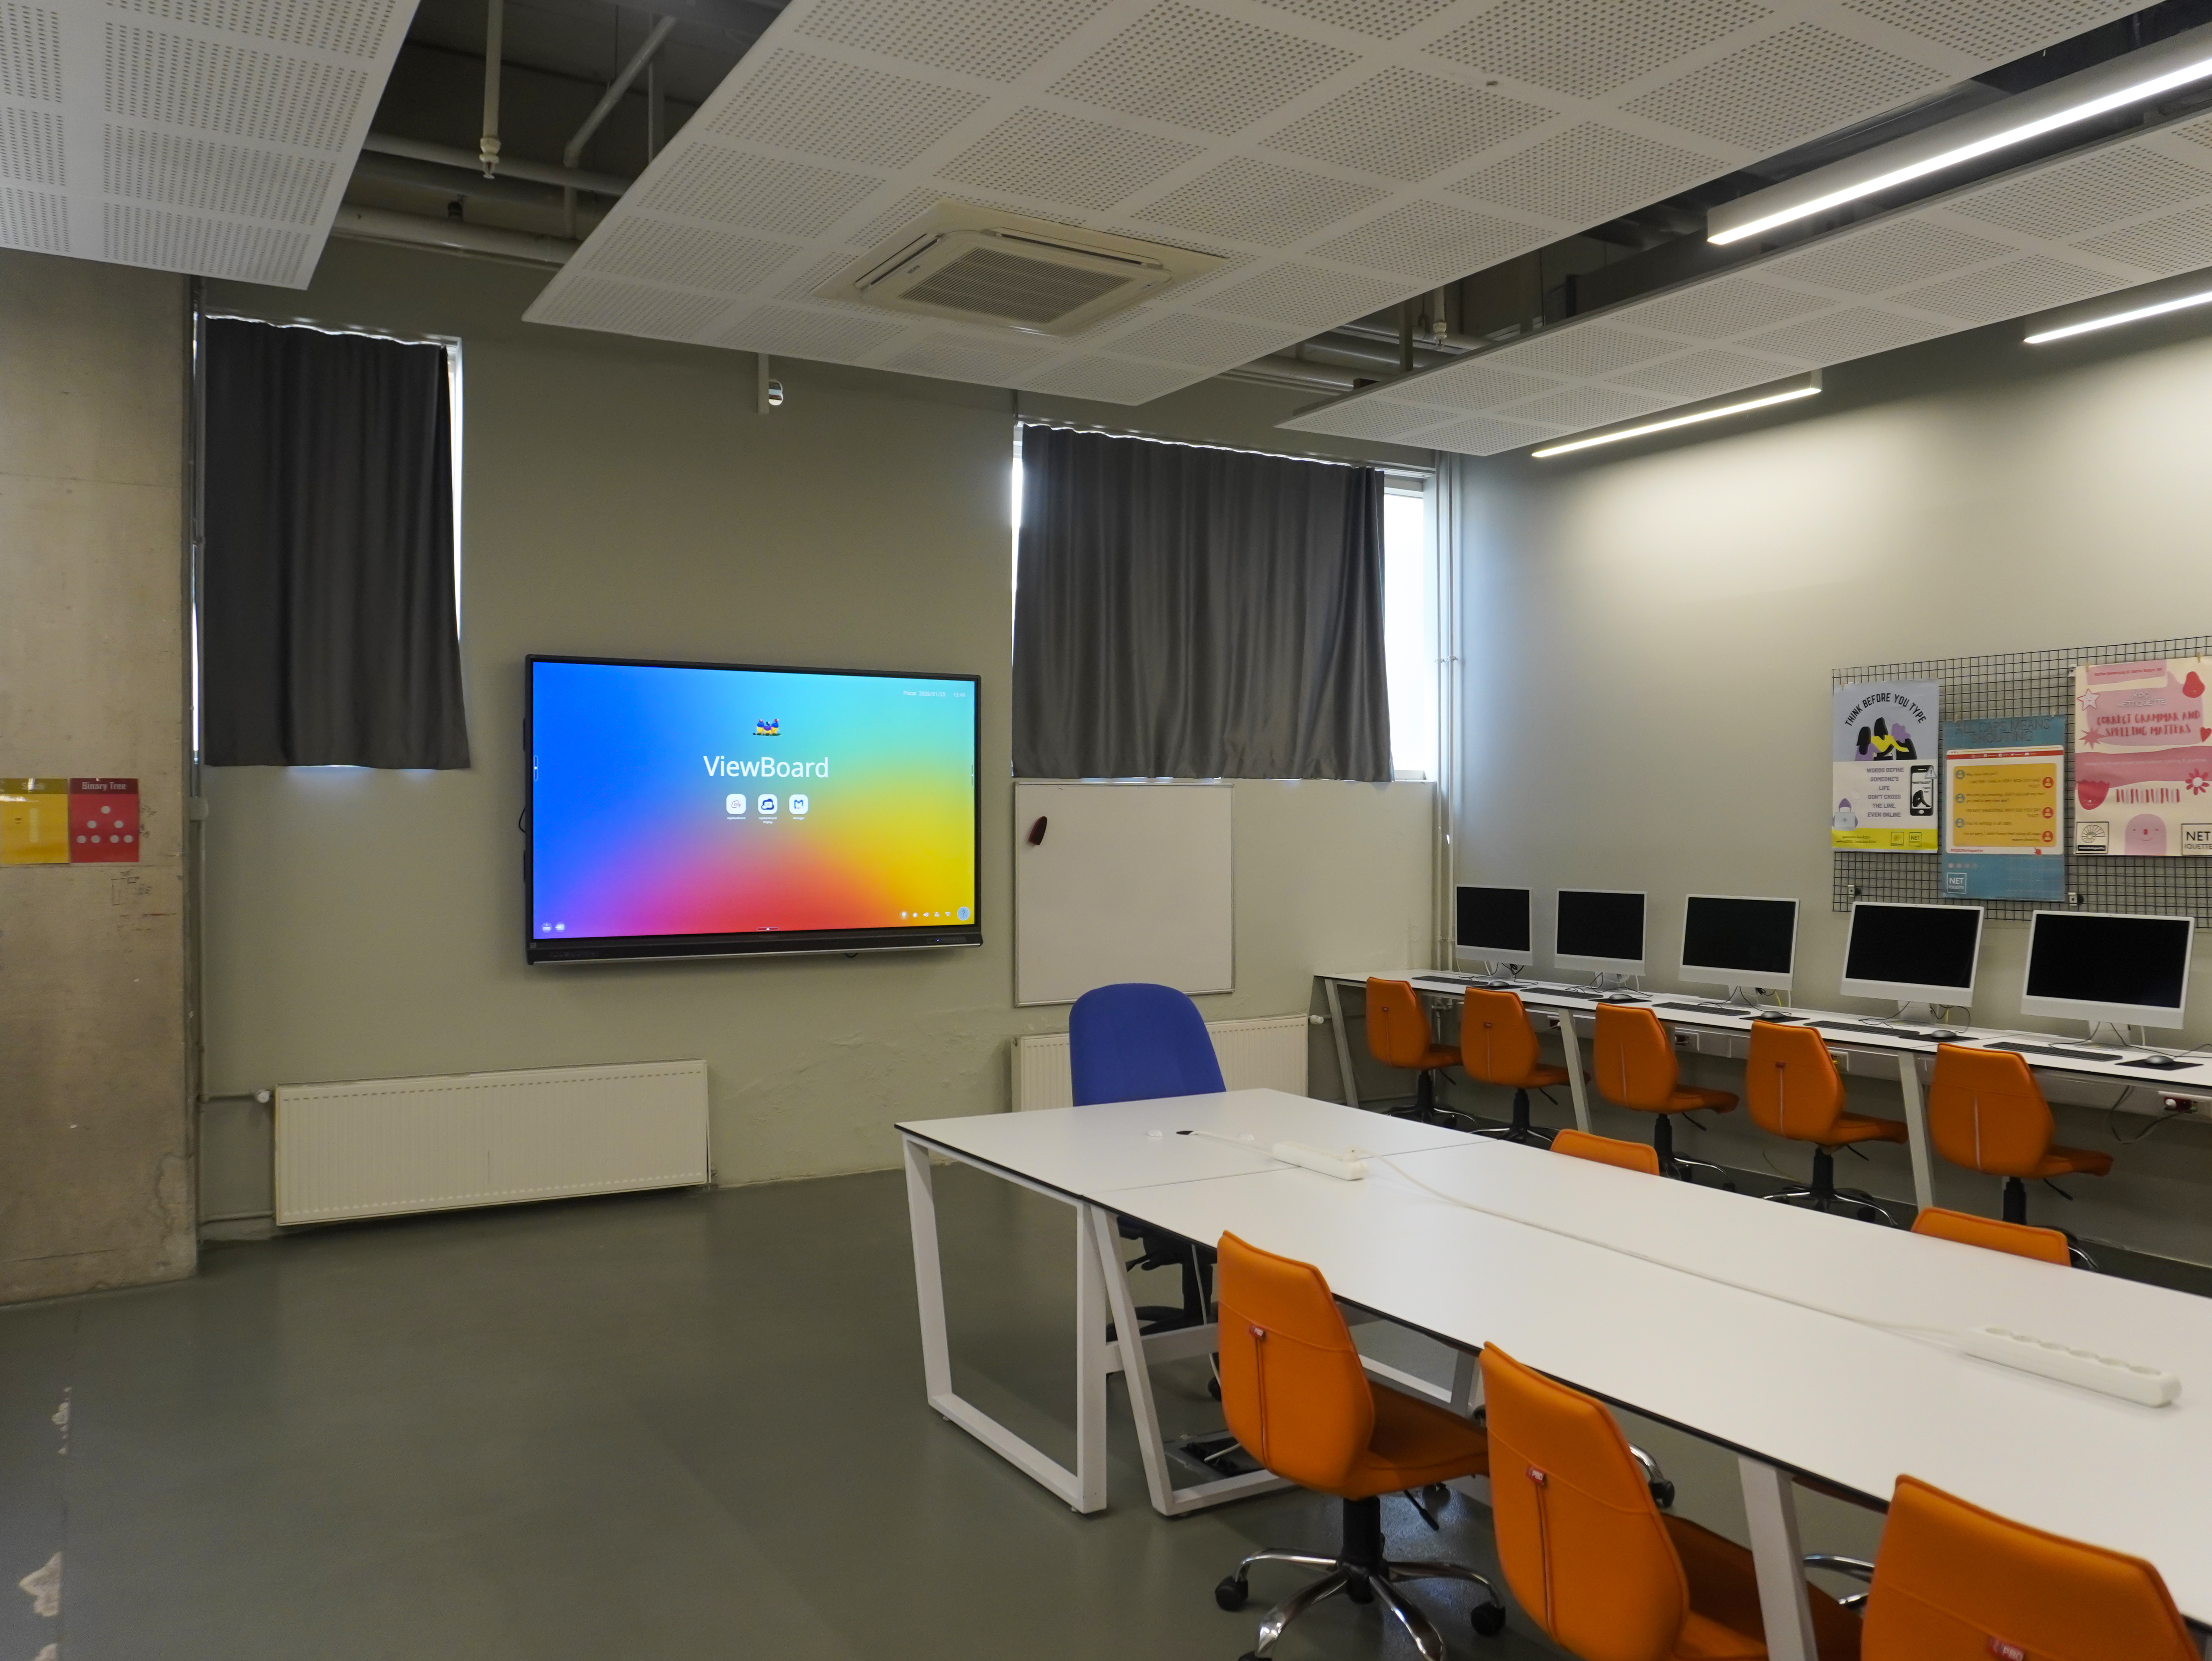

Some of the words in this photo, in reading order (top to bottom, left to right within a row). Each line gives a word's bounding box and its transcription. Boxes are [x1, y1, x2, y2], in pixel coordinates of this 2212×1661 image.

[1845, 704, 1863, 726] THINK
[1862, 693, 1891, 708] BEFORE
[1894, 694, 1910, 707] YOU
[1909, 702, 1927, 724] TYPE
[2182, 710, 2201, 721] AND
[1956, 723, 1976, 734] ALL
[1979, 721, 2007, 733] CAPS
[2011, 718, 2050, 731] MEANS
[2150, 723, 2192, 735] MATTERS
[1972, 730, 2033, 744] SHOUTING
[703, 755, 829, 778] ViewBoard
[81, 782, 107, 791] Binary
[109, 782, 127, 790] Tree
[2186, 831, 2211, 841] NET
